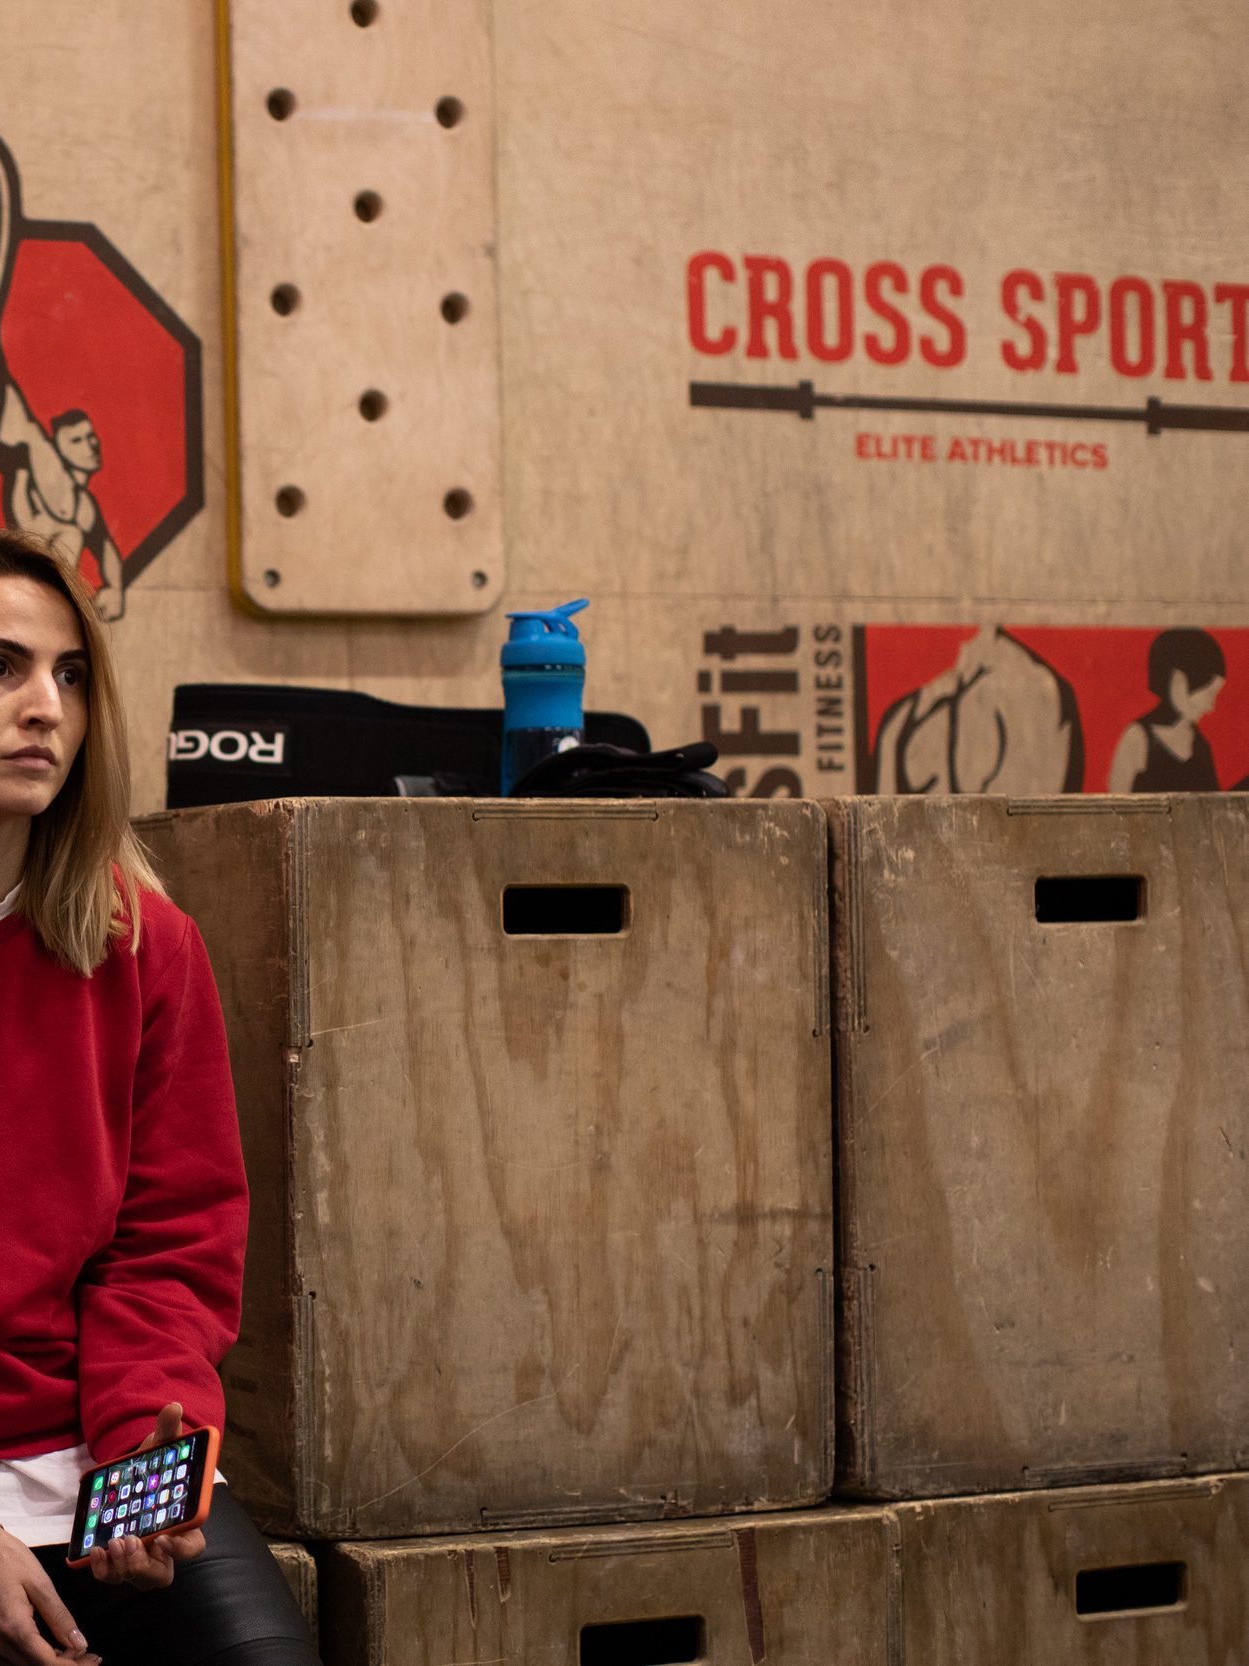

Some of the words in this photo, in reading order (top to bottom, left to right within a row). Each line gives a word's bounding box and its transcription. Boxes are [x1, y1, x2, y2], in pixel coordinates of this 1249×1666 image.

[686, 250, 967, 368] CROSS
[1001, 269, 1249, 383] SPORT
[854, 431, 937, 462] ELITE
[946, 436, 1109, 469] ATHLETICS
[813, 624, 844, 773] FITNESS
[169, 730, 284, 764] ROG
